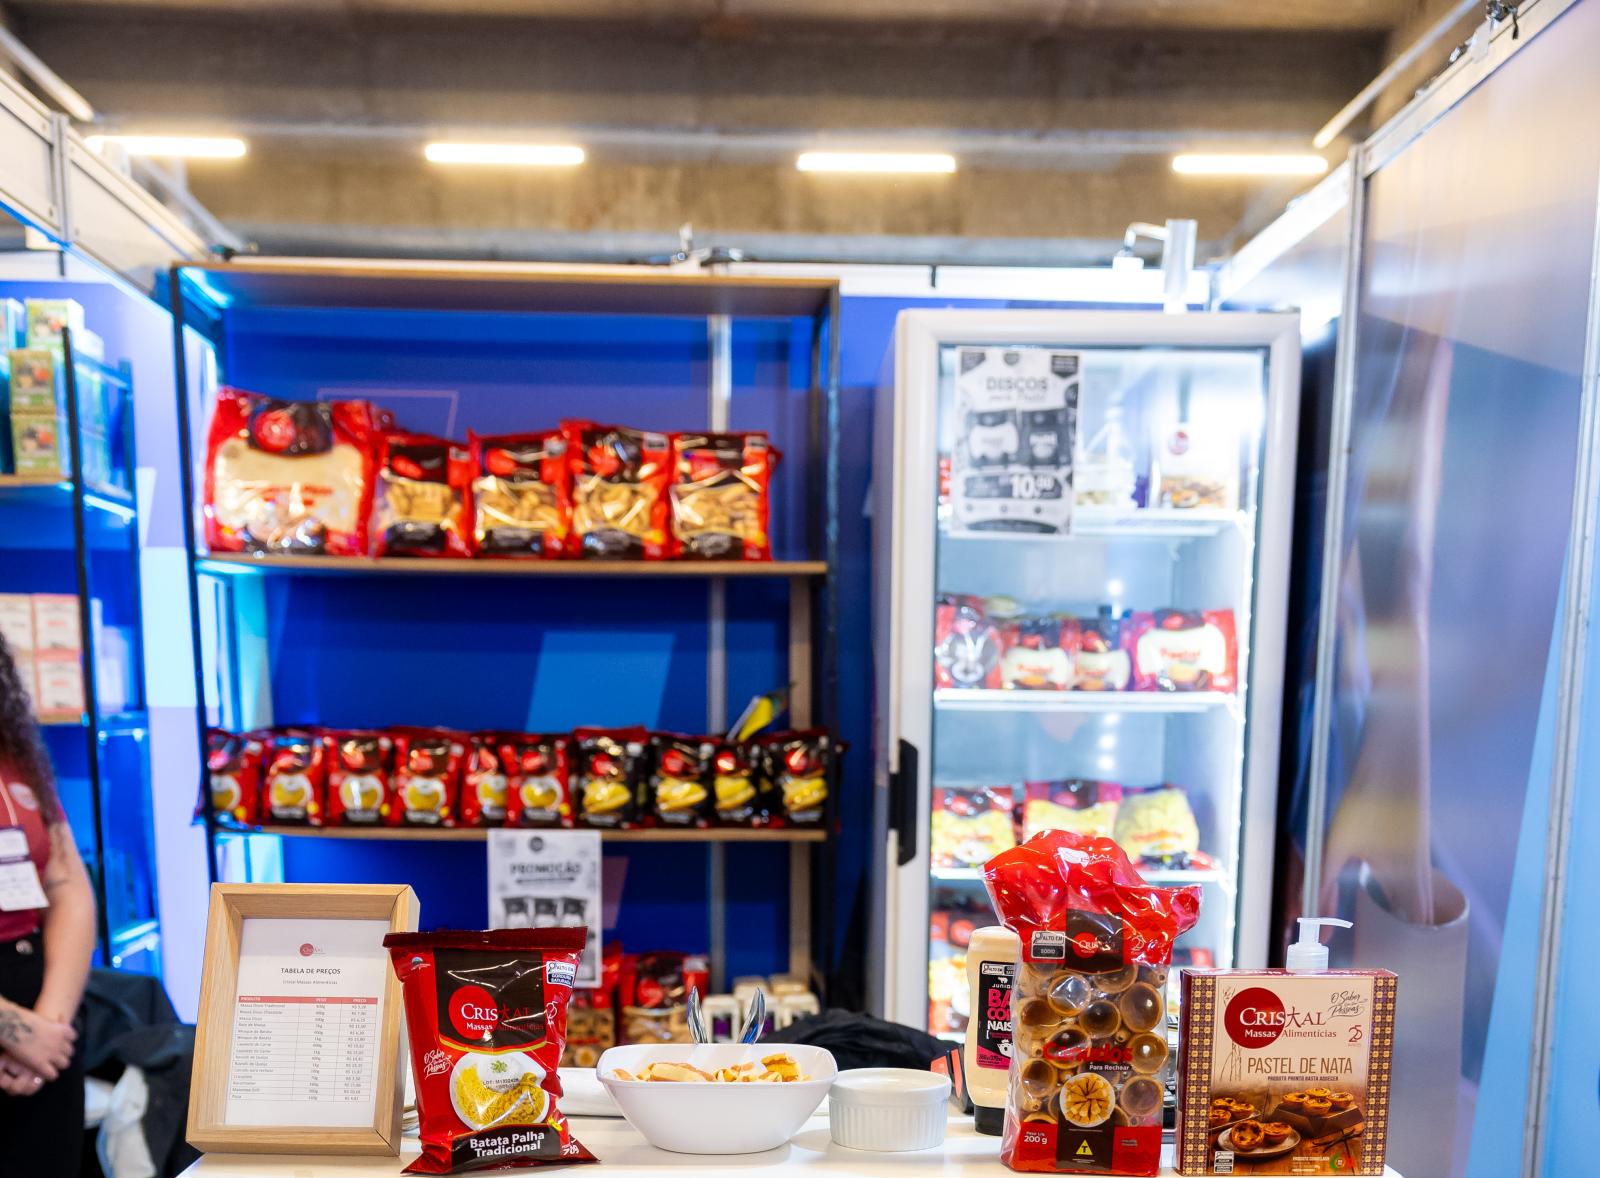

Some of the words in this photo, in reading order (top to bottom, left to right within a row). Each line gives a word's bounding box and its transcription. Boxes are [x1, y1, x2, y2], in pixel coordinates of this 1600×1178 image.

[510, 862, 581, 874] PROMOÇÃO
[466, 1022, 493, 1031] Massas
[1245, 1029, 1276, 1038] Massas
[1282, 1029, 1337, 1038] Alimentícias
[1248, 1057, 1295, 1074] PASTEL
[1300, 1057, 1317, 1074] DE
[1321, 1057, 1353, 1074] NATA
[470, 1136, 510, 1149] Batata
[512, 1131, 545, 1145] Palha
[475, 1141, 541, 1157] Tradicional
